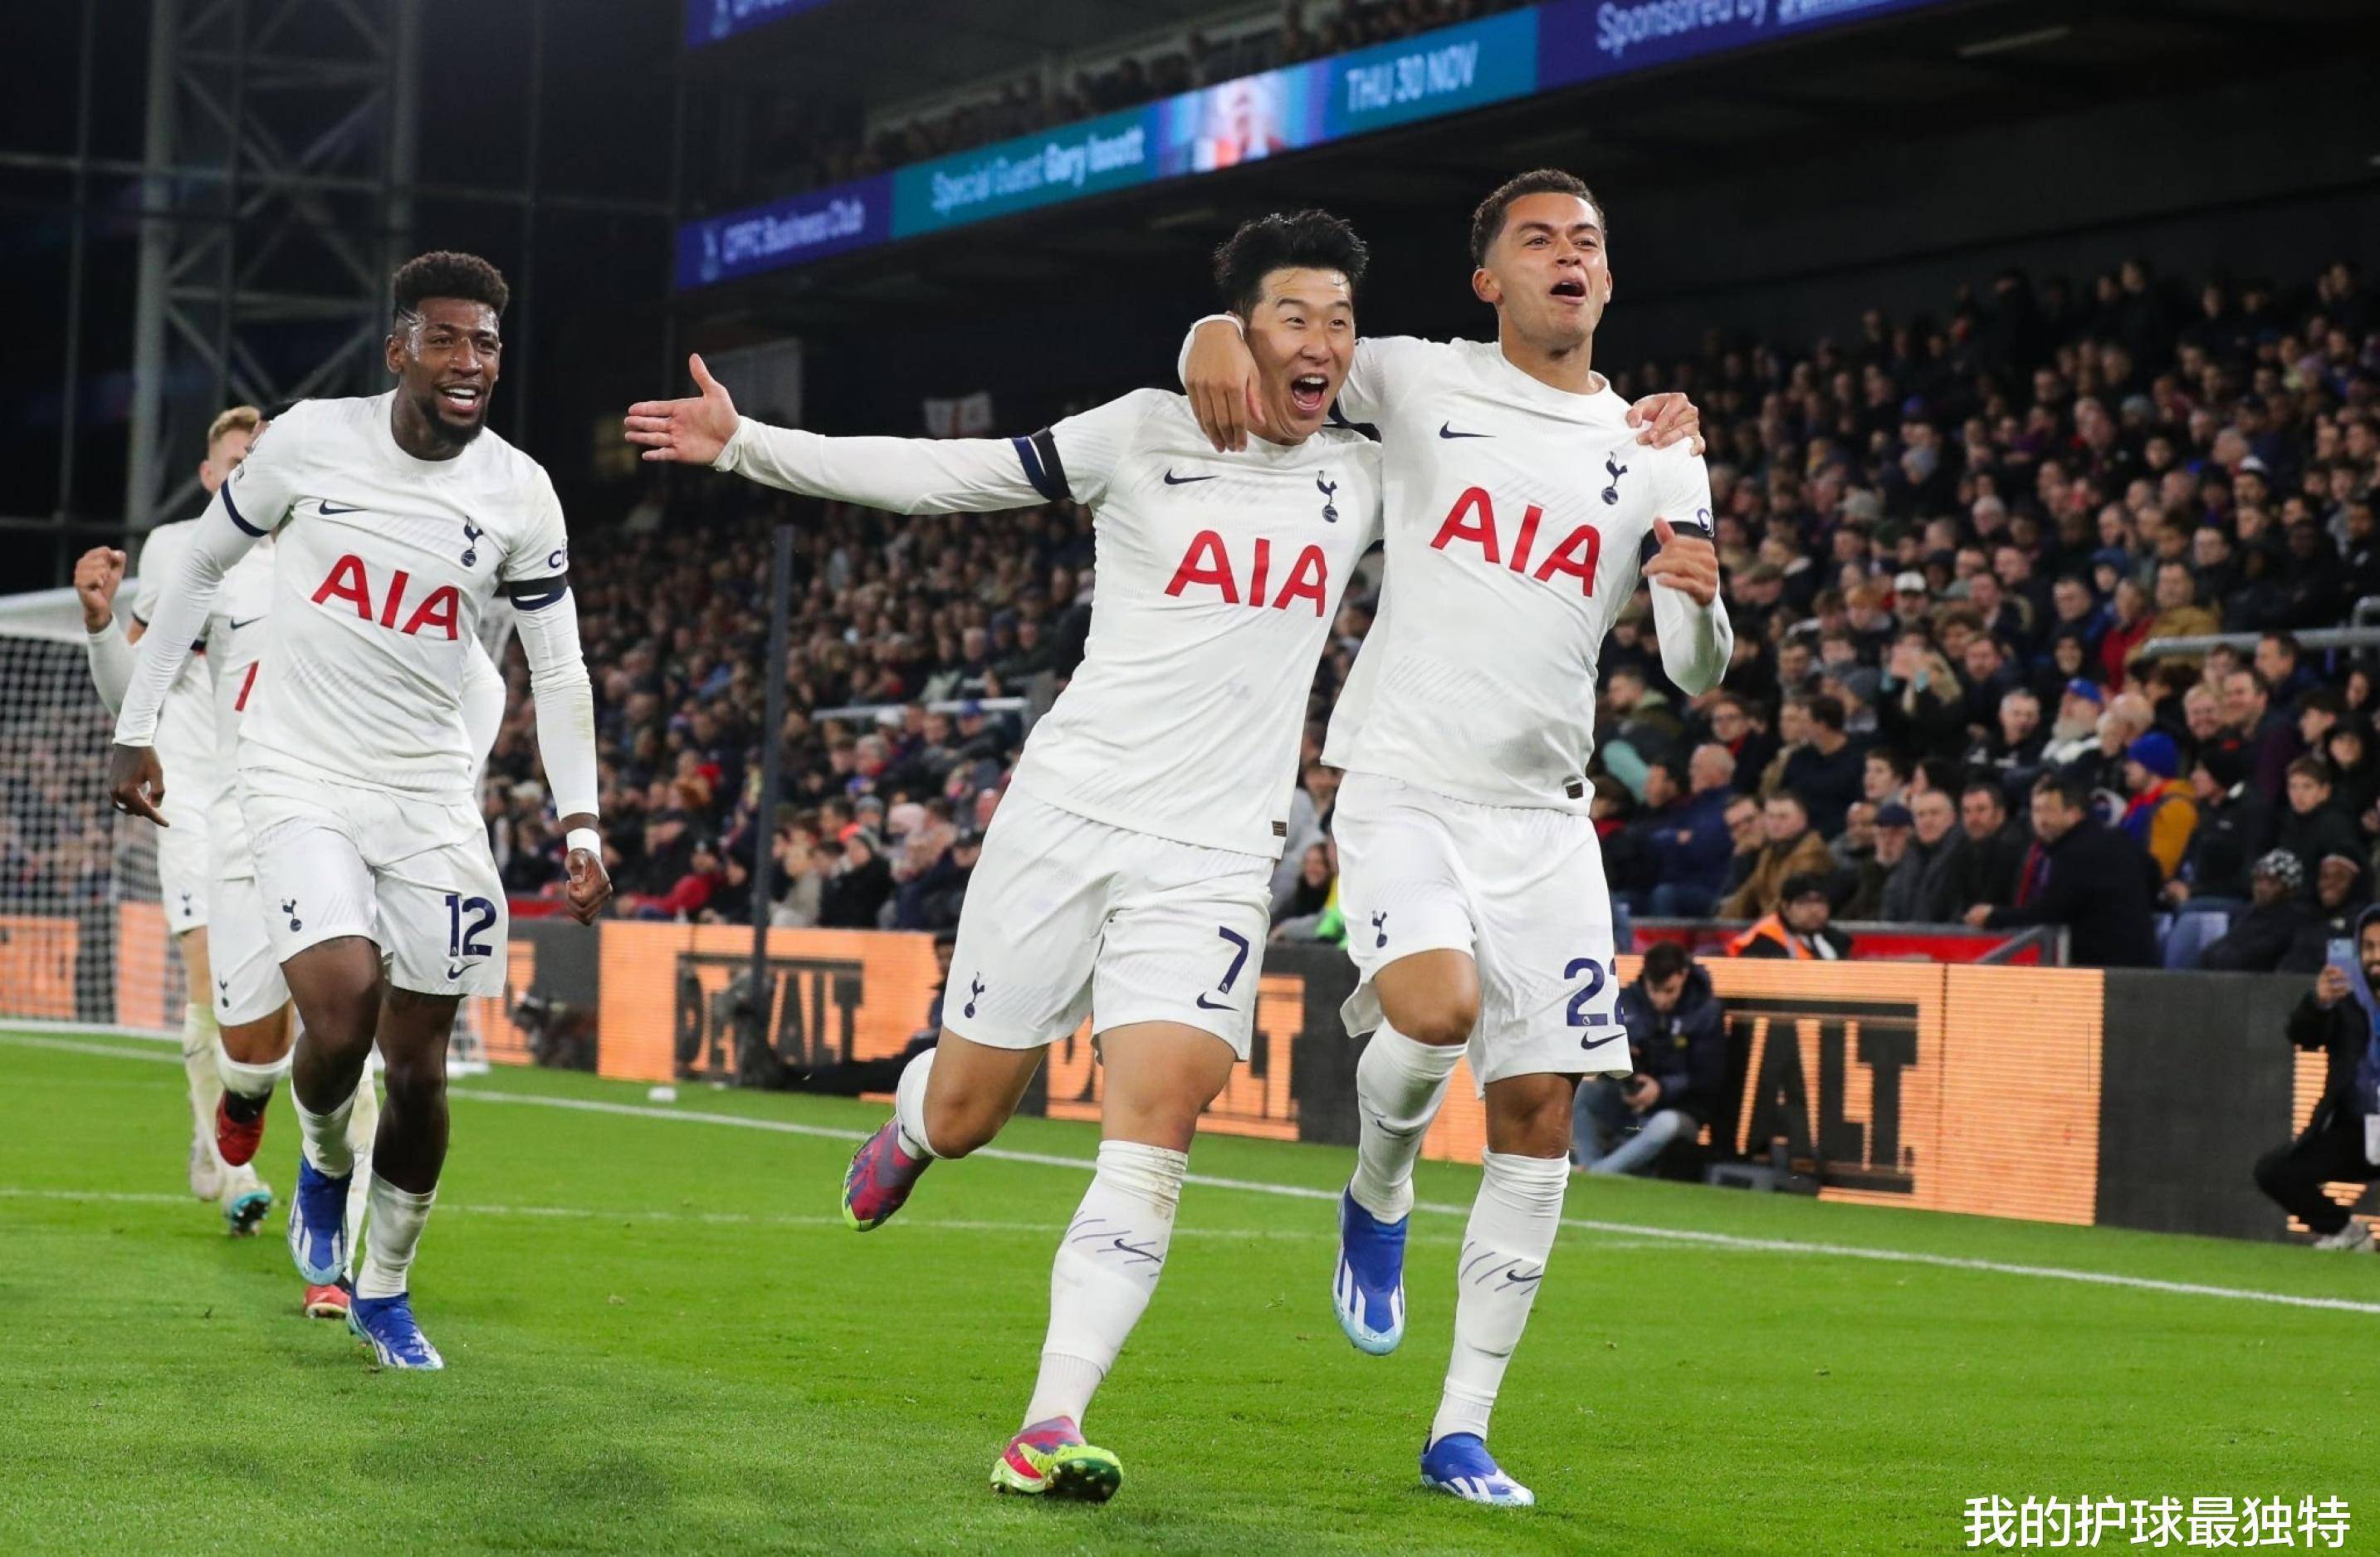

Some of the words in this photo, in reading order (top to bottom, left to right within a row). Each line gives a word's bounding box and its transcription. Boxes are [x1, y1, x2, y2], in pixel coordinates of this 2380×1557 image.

[1346, 63, 1395, 111] THU
[1395, 53, 1425, 102] 30
[1427, 41, 1478, 93] NOV
[1164, 530, 1327, 617] AIA
[1430, 487, 1600, 597] AIA
[311, 555, 459, 640] AIA
[445, 894, 497, 957] 12
[1218, 926, 1249, 995] 7
